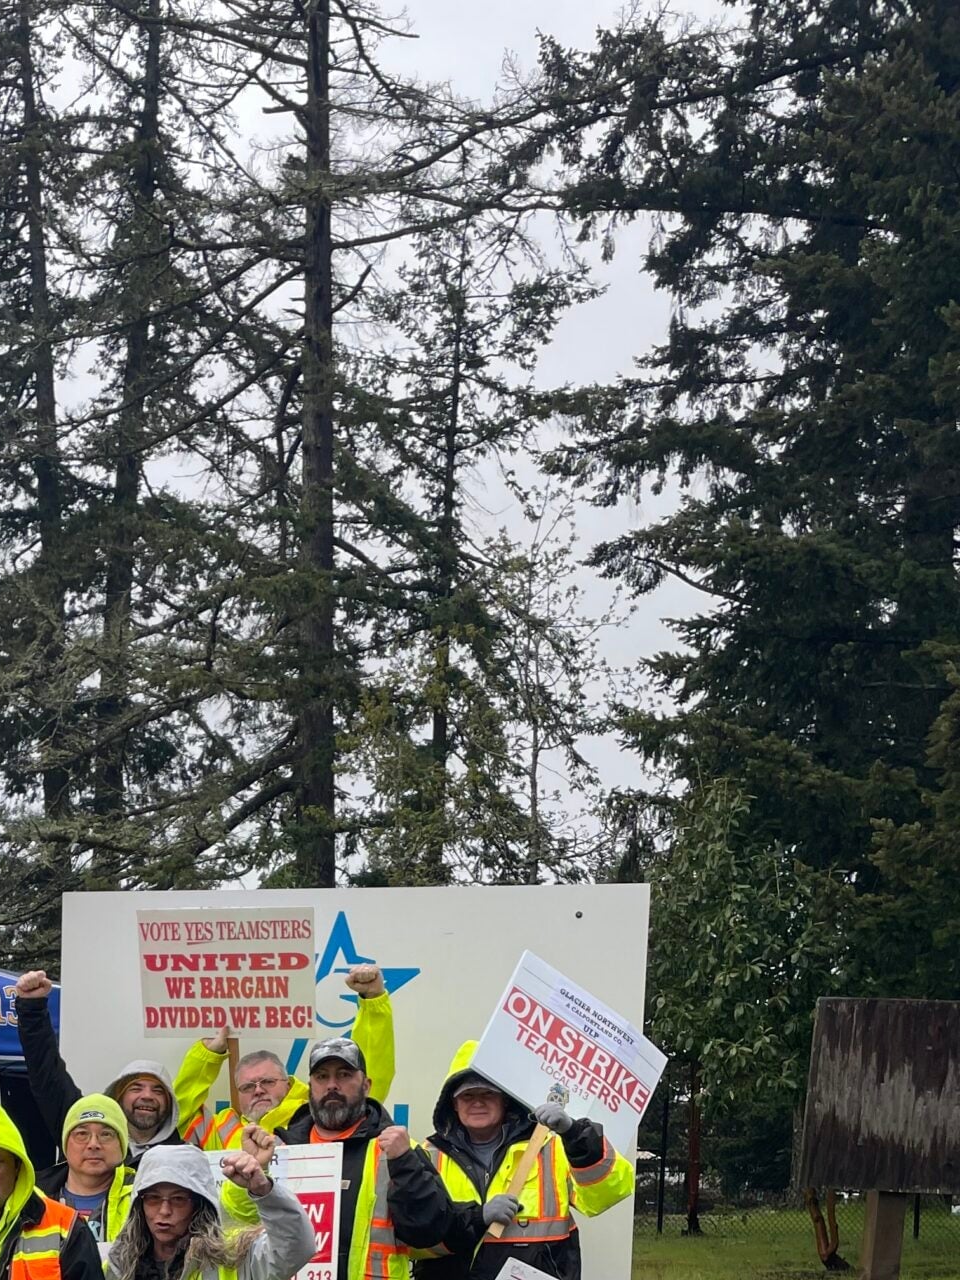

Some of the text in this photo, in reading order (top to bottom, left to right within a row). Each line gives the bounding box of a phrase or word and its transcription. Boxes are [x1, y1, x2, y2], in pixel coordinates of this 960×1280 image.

[139, 920, 311, 942] VOTE YES TEAMSTERS
[143, 952, 309, 972] UNITED
[165, 976, 289, 999] WE BARGAIN
[145, 1006, 313, 1028] DIVIDED WE BEG!
[560, 988, 635, 1045] GLACIER NORTHWEST
[571, 1006, 613, 1038] CALPORTLAND
[583, 1025, 600, 1038] ULP
[507, 992, 651, 1113] ON STRIKE
[515, 1024, 621, 1113] TEAMSTERS
[540, 1063, 590, 1100] LOCAL 313
